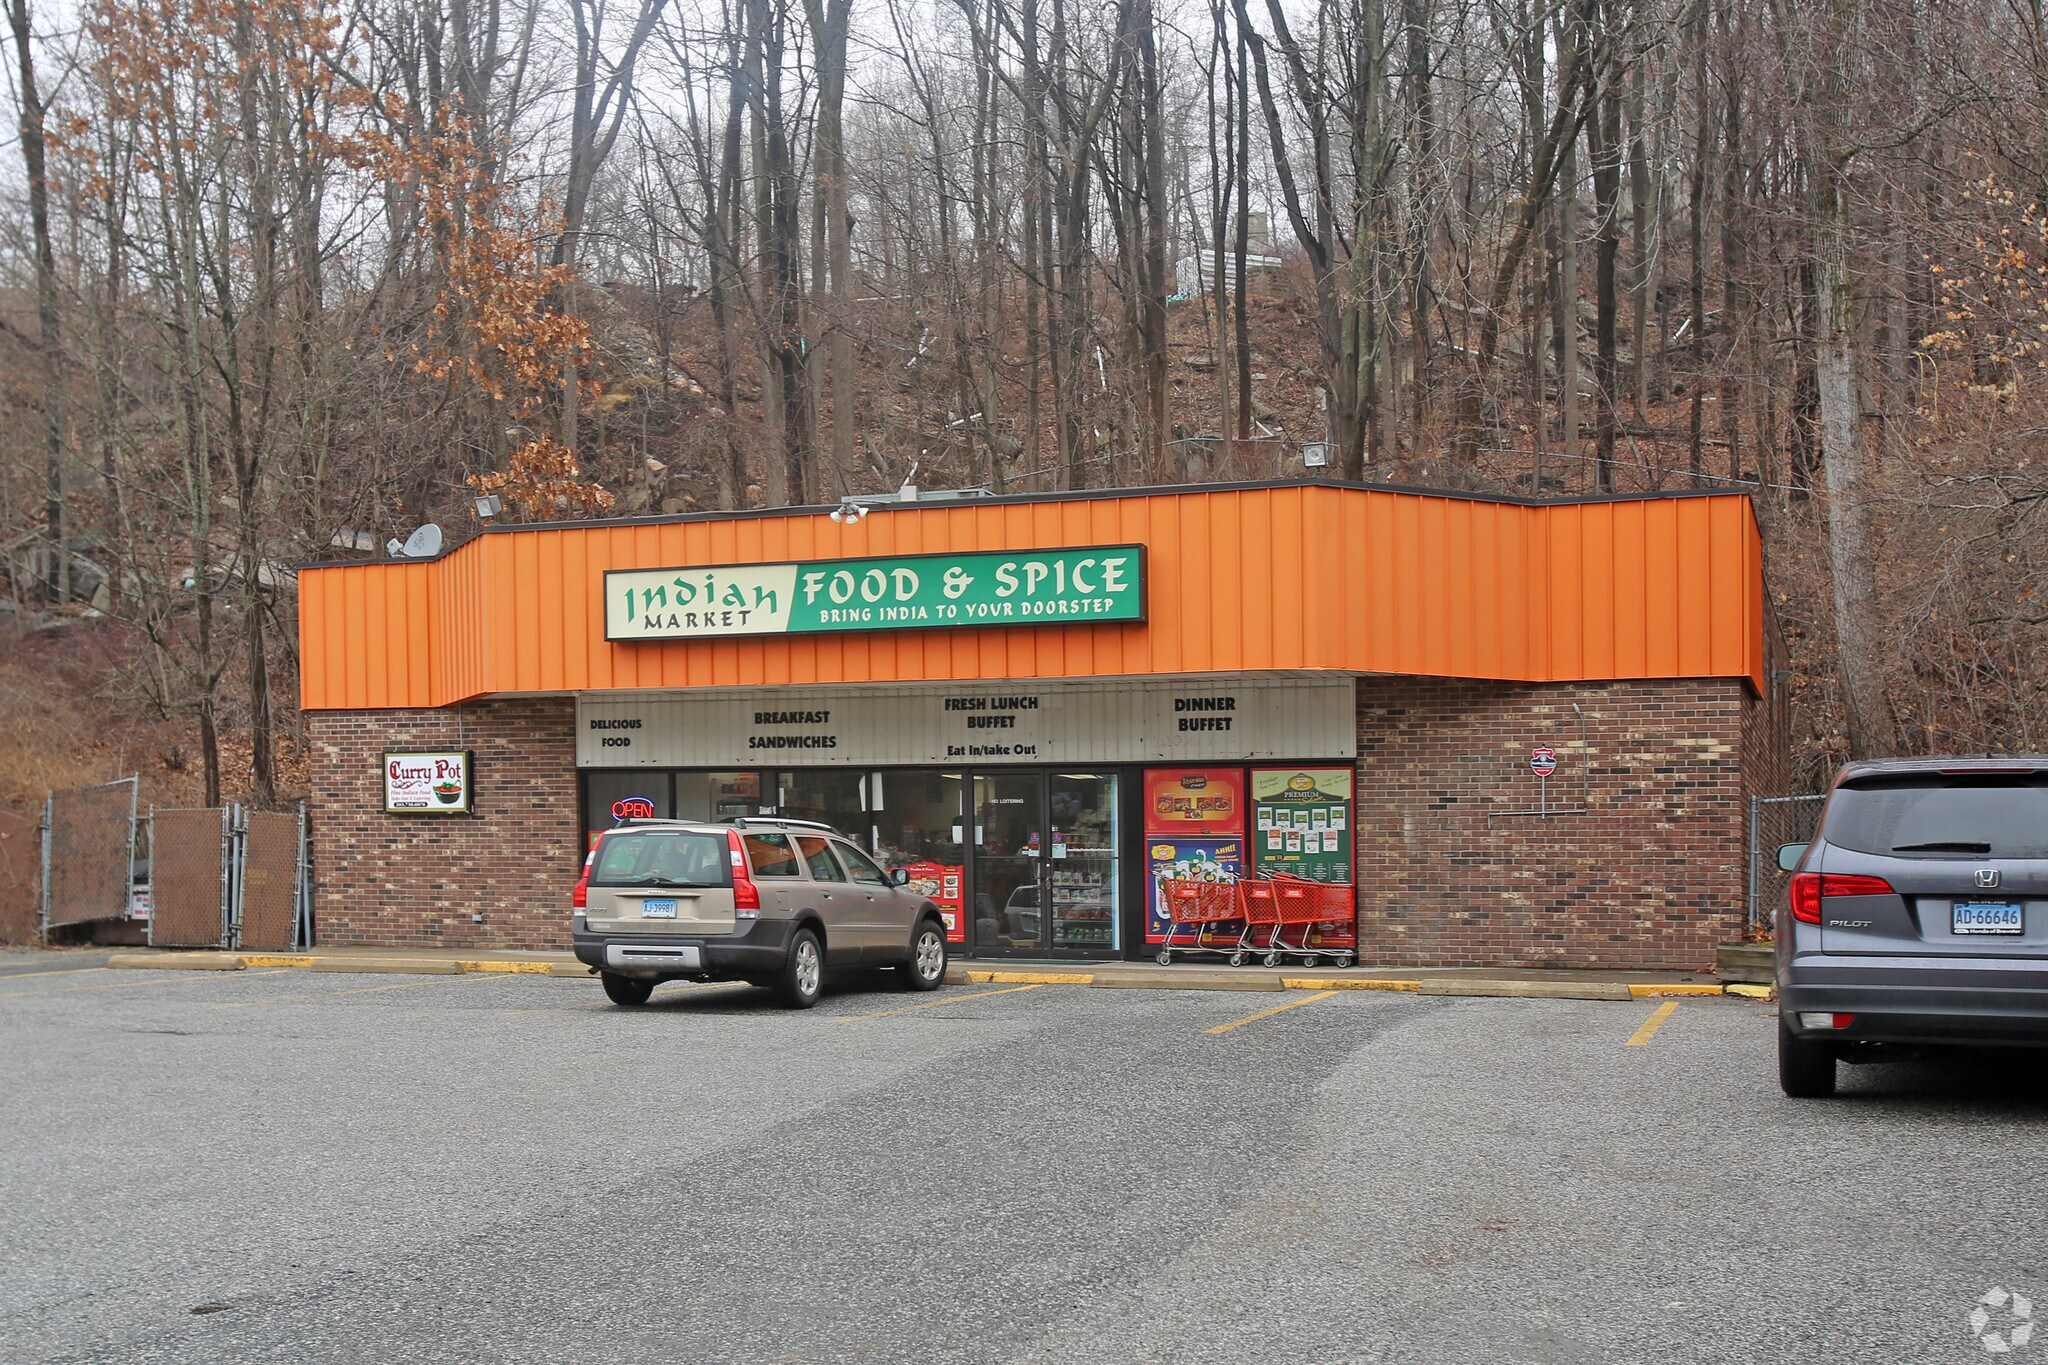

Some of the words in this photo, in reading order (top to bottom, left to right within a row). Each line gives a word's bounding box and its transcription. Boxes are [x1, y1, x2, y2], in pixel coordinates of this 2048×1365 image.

[802, 568, 919, 605] FOOD
[943, 567, 974, 599] &
[995, 558, 1128, 597] SPICE
[624, 573, 777, 623] Indian
[820, 608, 871, 623] BRING
[879, 606, 928, 621] INDIA
[936, 604, 957, 619] TO
[965, 602, 1013, 618] YOUR
[1021, 598, 1114, 616] DOORSTEP
[644, 610, 752, 630] MARKET
[945, 698, 986, 711] FRESH
[991, 696, 1038, 710] LUNCH
[1174, 697, 1236, 711] DINNER
[590, 719, 642, 729] DELICIOUS
[754, 711, 830, 724] BREAKFAST
[967, 715, 1016, 728] BUFFET
[1178, 717, 1233, 731] BUFFET
[602, 737, 631, 747] FOOD
[748, 735, 837, 749] SANDWICHES
[947, 745, 966, 756] Eat
[969, 744, 1011, 756] In/take
[1013, 744, 1037, 755] Out
[389, 760, 431, 784] Curry
[434, 759, 462, 779] Pot
[612, 801, 653, 818] OPEN
[643, 904, 674, 913] AJ-39981
